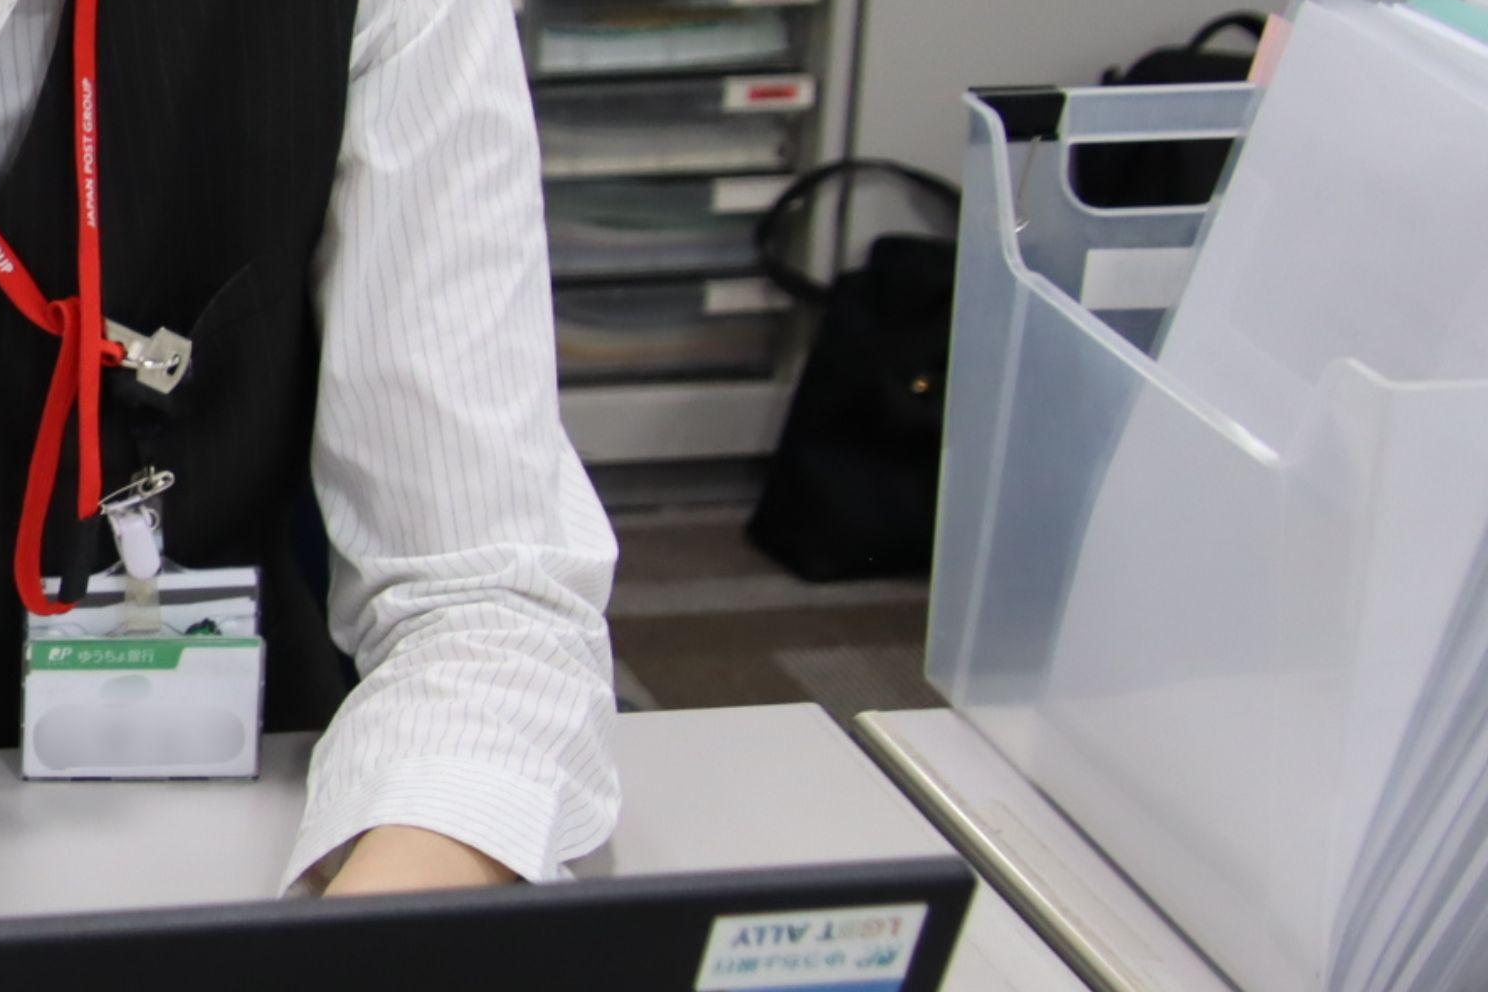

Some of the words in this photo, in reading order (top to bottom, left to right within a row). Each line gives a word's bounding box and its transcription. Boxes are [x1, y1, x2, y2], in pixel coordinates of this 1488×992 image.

[81, 77, 94, 133] GROUP
[82, 135, 94, 175] POST
[84, 177, 97, 228] JAPAN
[731, 922, 810, 948] ALLY
